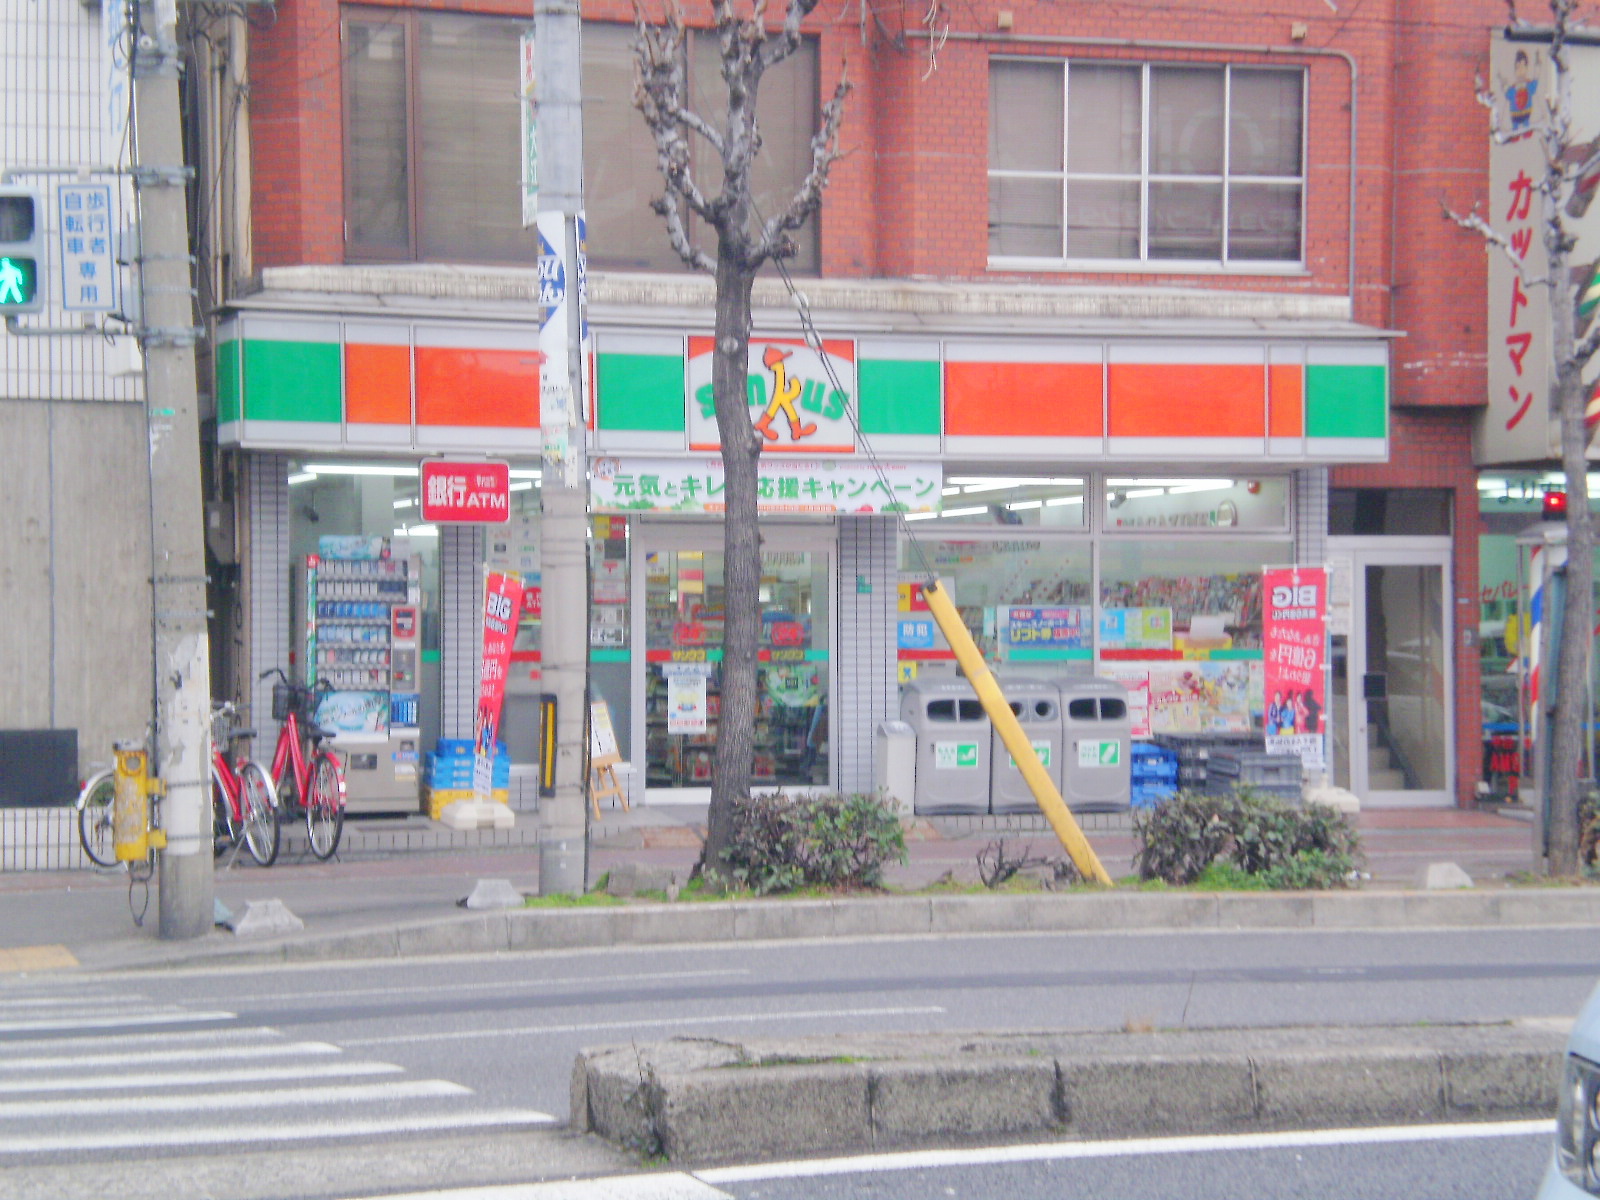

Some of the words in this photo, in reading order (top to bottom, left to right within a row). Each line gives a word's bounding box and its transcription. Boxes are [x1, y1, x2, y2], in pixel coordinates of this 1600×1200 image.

[65, 192, 84, 254] 自転車
[88, 192, 106, 254] 歩行者
[80, 261, 98, 303] 専用
[1506, 169, 1533, 431] カットマン
[428, 475, 467, 507] 銀行
[467, 492, 506, 509] ATM
[613, 474, 935, 499] 元気とキレ応援キャンペーン
[487, 592, 513, 621] BIG
